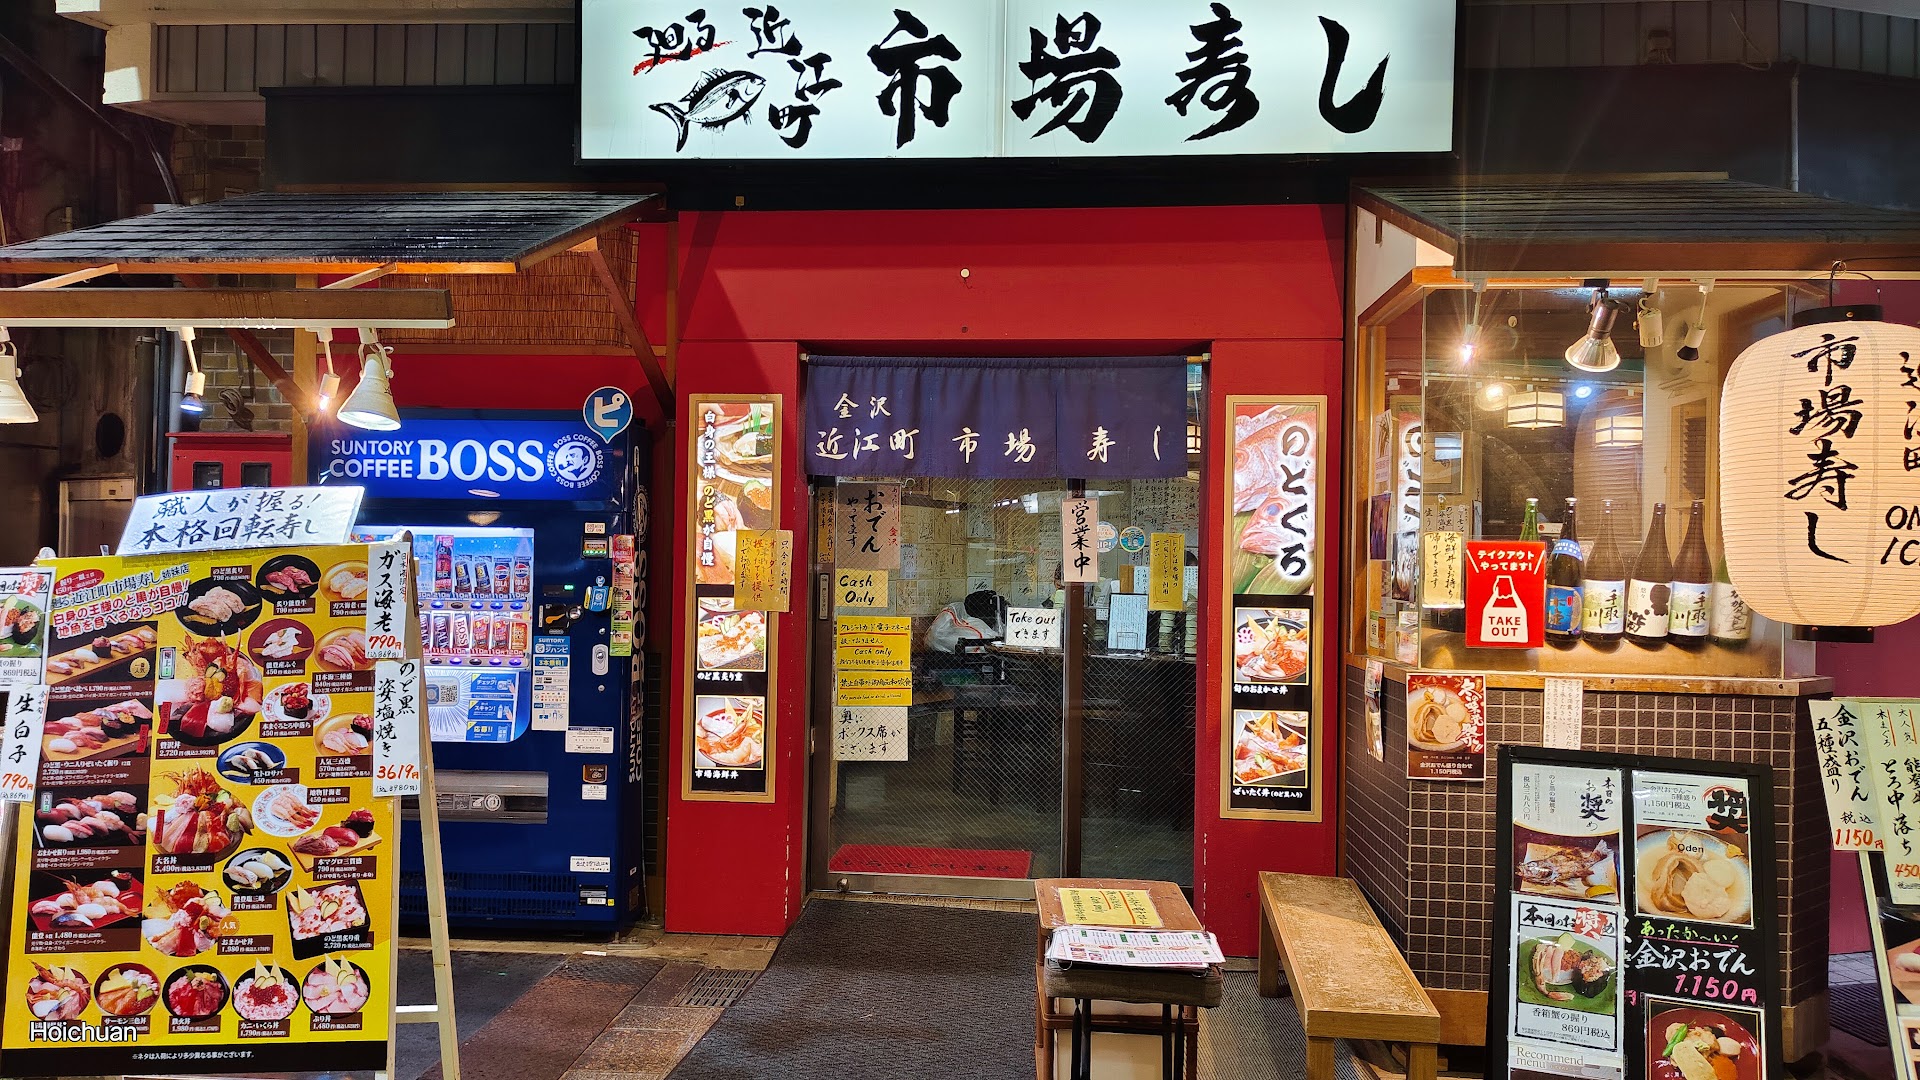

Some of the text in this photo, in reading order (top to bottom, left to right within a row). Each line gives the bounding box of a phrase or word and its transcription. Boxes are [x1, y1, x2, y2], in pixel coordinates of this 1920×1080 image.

[867, 3, 1391, 148] 市場寿し
[833, 393, 892, 419] 金沢
[331, 440, 414, 456] SUNTORY
[1784, 333, 1864, 564] 市場寿し
[329, 459, 413, 478] COFFEE
[417, 439, 544, 482] BOSS
[152, 490, 319, 519] 職人が握る!
[1280, 425, 1311, 577] のどぐろ
[861, 490, 887, 553] おでん
[137, 516, 320, 549] 本格回転寿し
[1071, 500, 1091, 577] 営業中
[1477, 550, 1535, 560] テイクアウト
[1480, 562, 1532, 571] やってます!
[840, 575, 873, 588] Cash
[374, 549, 400, 632] ガス海老
[845, 590, 875, 606] Only
[1010, 612, 1033, 623] Take
[1489, 616, 1521, 625] TAKE
[1014, 628, 1050, 640] できます
[1492, 627, 1518, 637] OUT
[368, 634, 402, 650] 790円
[3, 669, 37, 677] 869円税込
[395, 662, 416, 715] のど黒
[375, 678, 398, 758] 姿塩焼き
[839, 708, 863, 724] 奥に
[8, 692, 35, 763] 生白子
[838, 725, 903, 740] ボックス席が
[1876, 707, 1891, 747] 本まぐろ
[839, 741, 889, 756] ございます
[1815, 717, 1843, 795] 五種盛り
[1831, 704, 1869, 802] 金沢おでん
[376, 764, 419, 780] 3619円
[695, 770, 739, 779] 市場海鮮丼
[2, 773, 34, 791] 790円
[1602, 777, 1616, 805] 本日の
[1643, 799, 1691, 810] 1,150円税込
[1880, 759, 1914, 856] とろ中落ち
[1840, 811, 1874, 824] 税込
[1677, 843, 1704, 853] Oden
[222, 922, 237, 930] 人気
[1522, 904, 1616, 941] 本日のお奨め
[1631, 938, 1755, 975] 金沢おでん
[1532, 1008, 1589, 1024] 香箱蟹の握り
[1561, 1023, 1610, 1039] 869円税込
[1516, 1057, 1546, 1069] menu
[1517, 1046, 1585, 1066] Recommend
